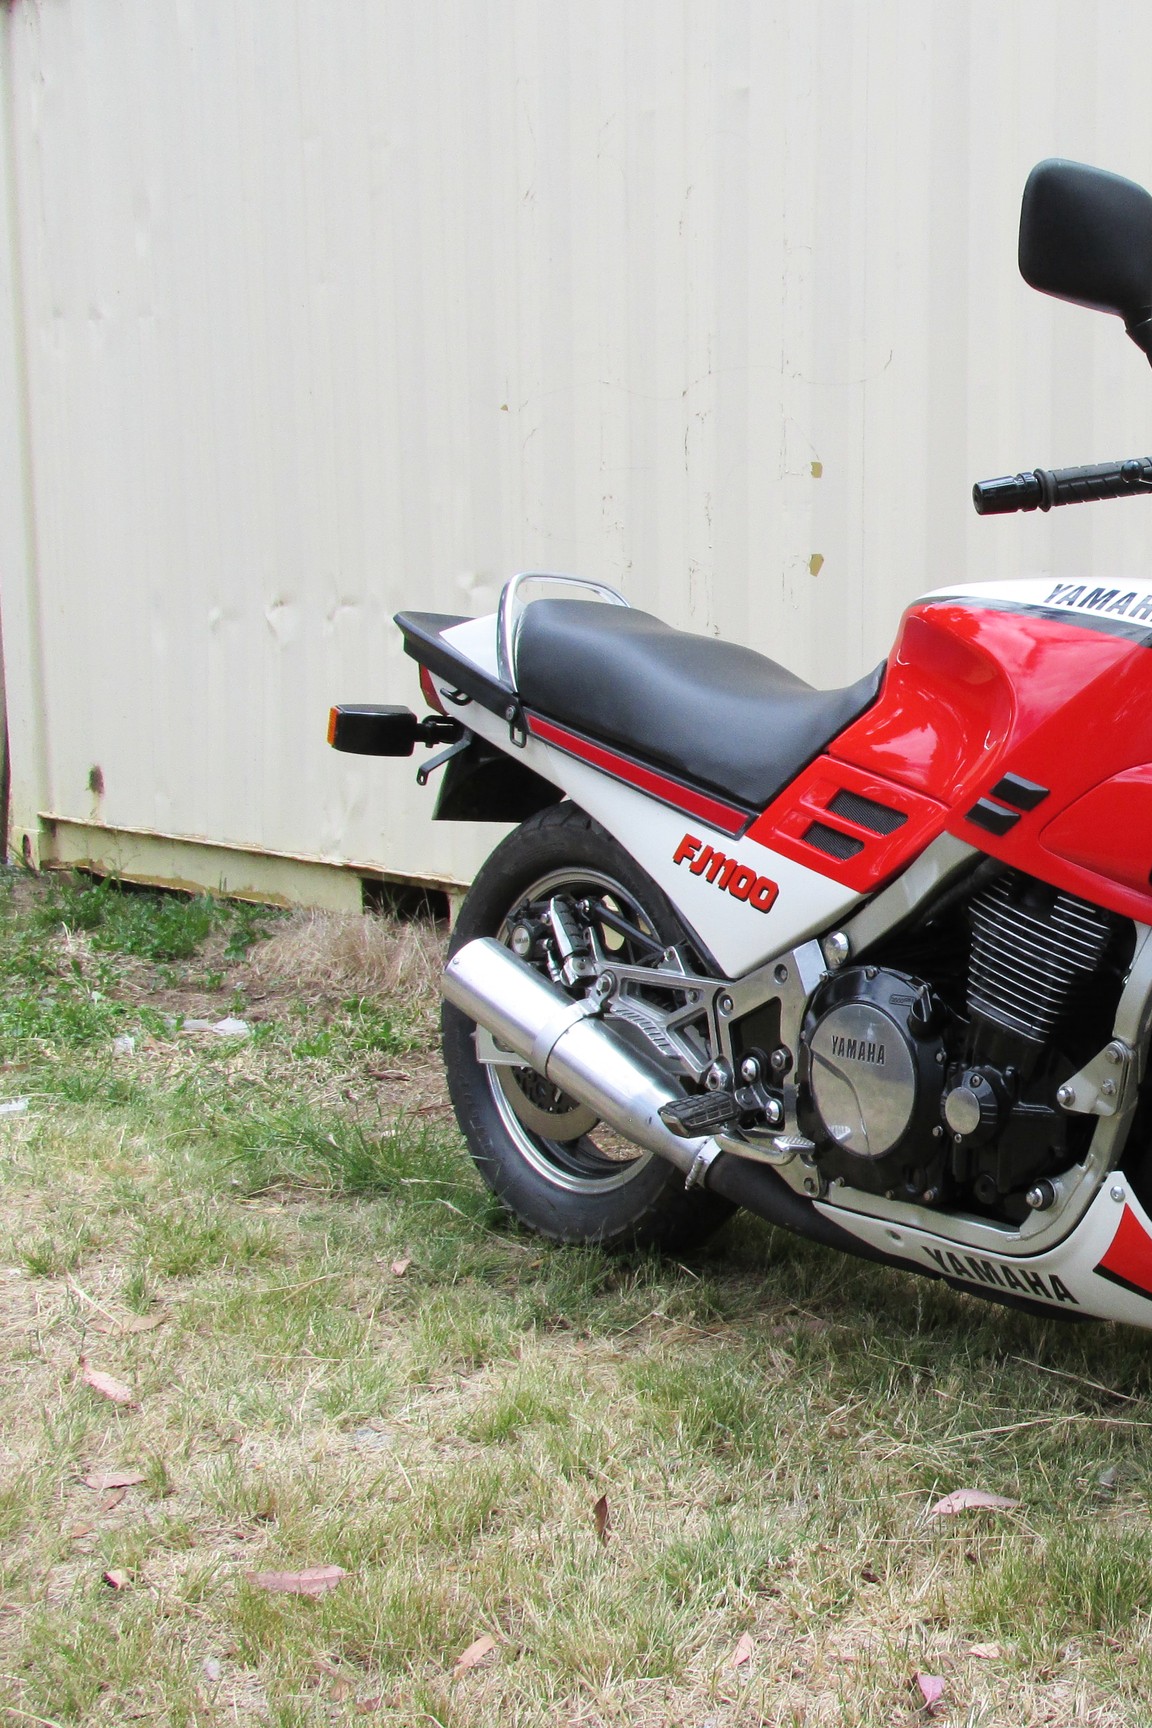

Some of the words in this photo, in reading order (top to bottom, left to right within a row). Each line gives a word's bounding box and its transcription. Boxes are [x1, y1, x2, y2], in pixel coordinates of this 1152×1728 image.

[672, 833, 779, 914] FJ1100
[831, 1035, 885, 1066] YAMAHA
[920, 1245, 1080, 1305] YAMAHA
